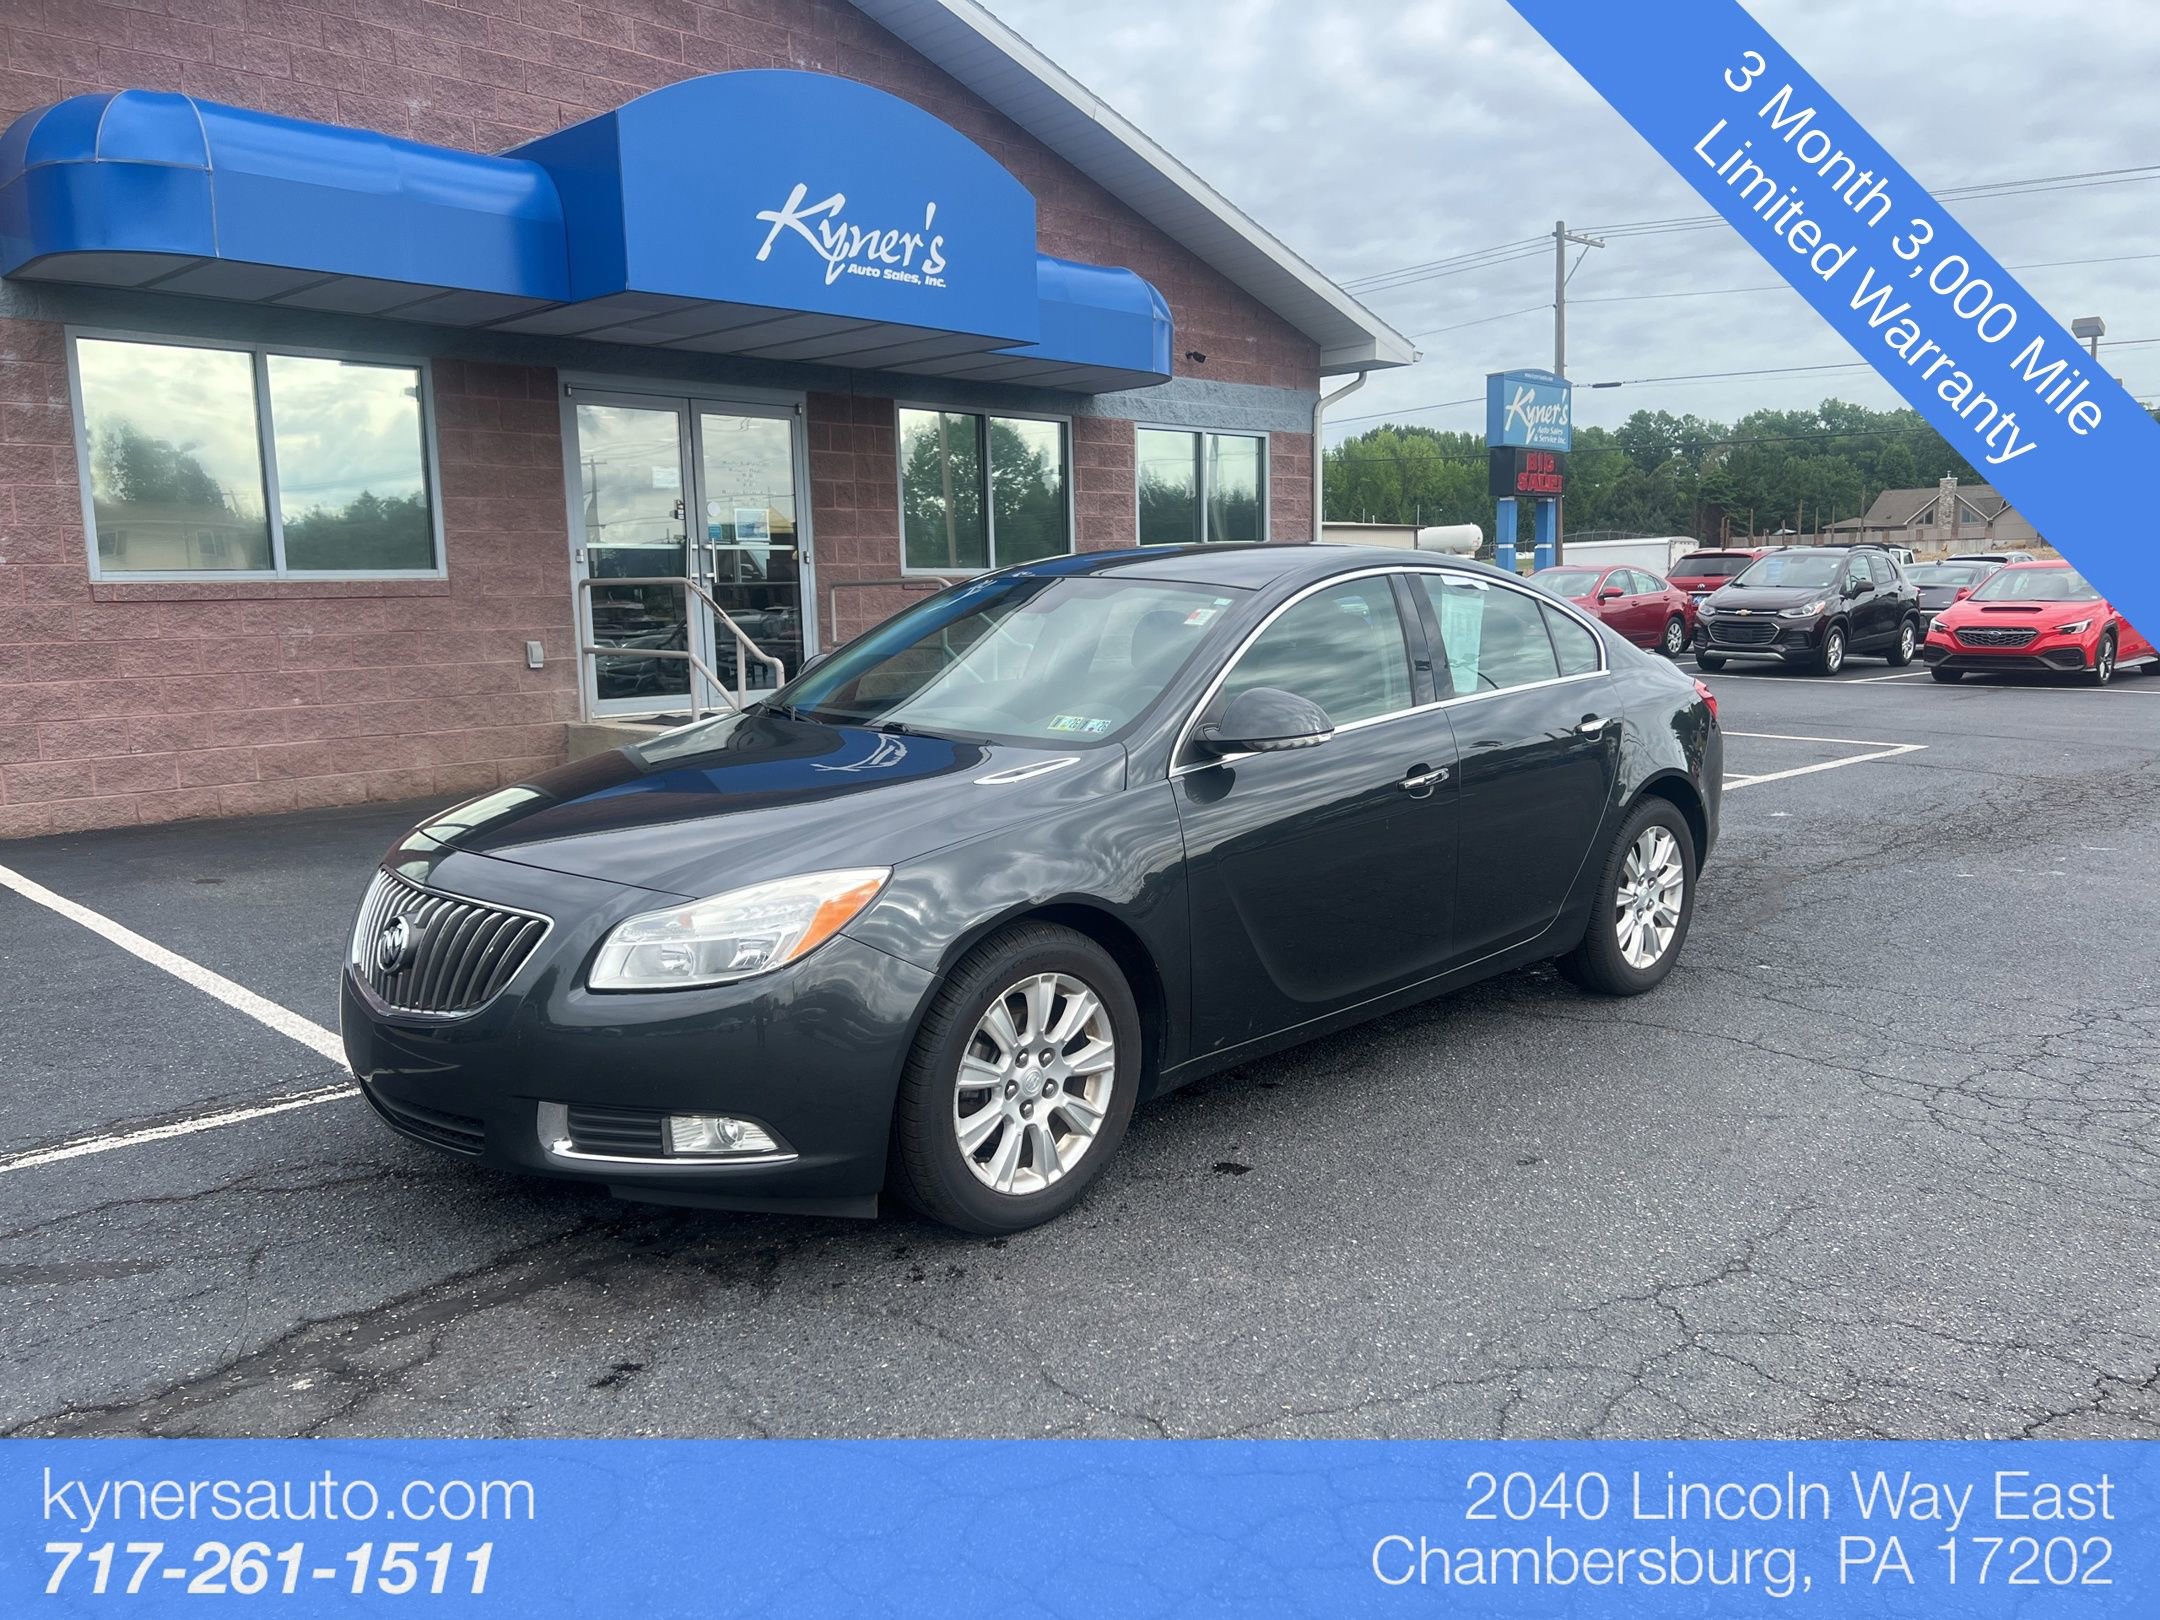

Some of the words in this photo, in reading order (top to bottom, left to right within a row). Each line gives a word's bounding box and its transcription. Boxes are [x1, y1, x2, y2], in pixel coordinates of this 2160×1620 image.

[756, 183, 946, 285] Kyner's
[848, 264, 880, 277] Auto
[883, 269, 921, 285] Sales,
[925, 276, 946, 288] Inc.
[1505, 386, 1568, 445] Kyner's
